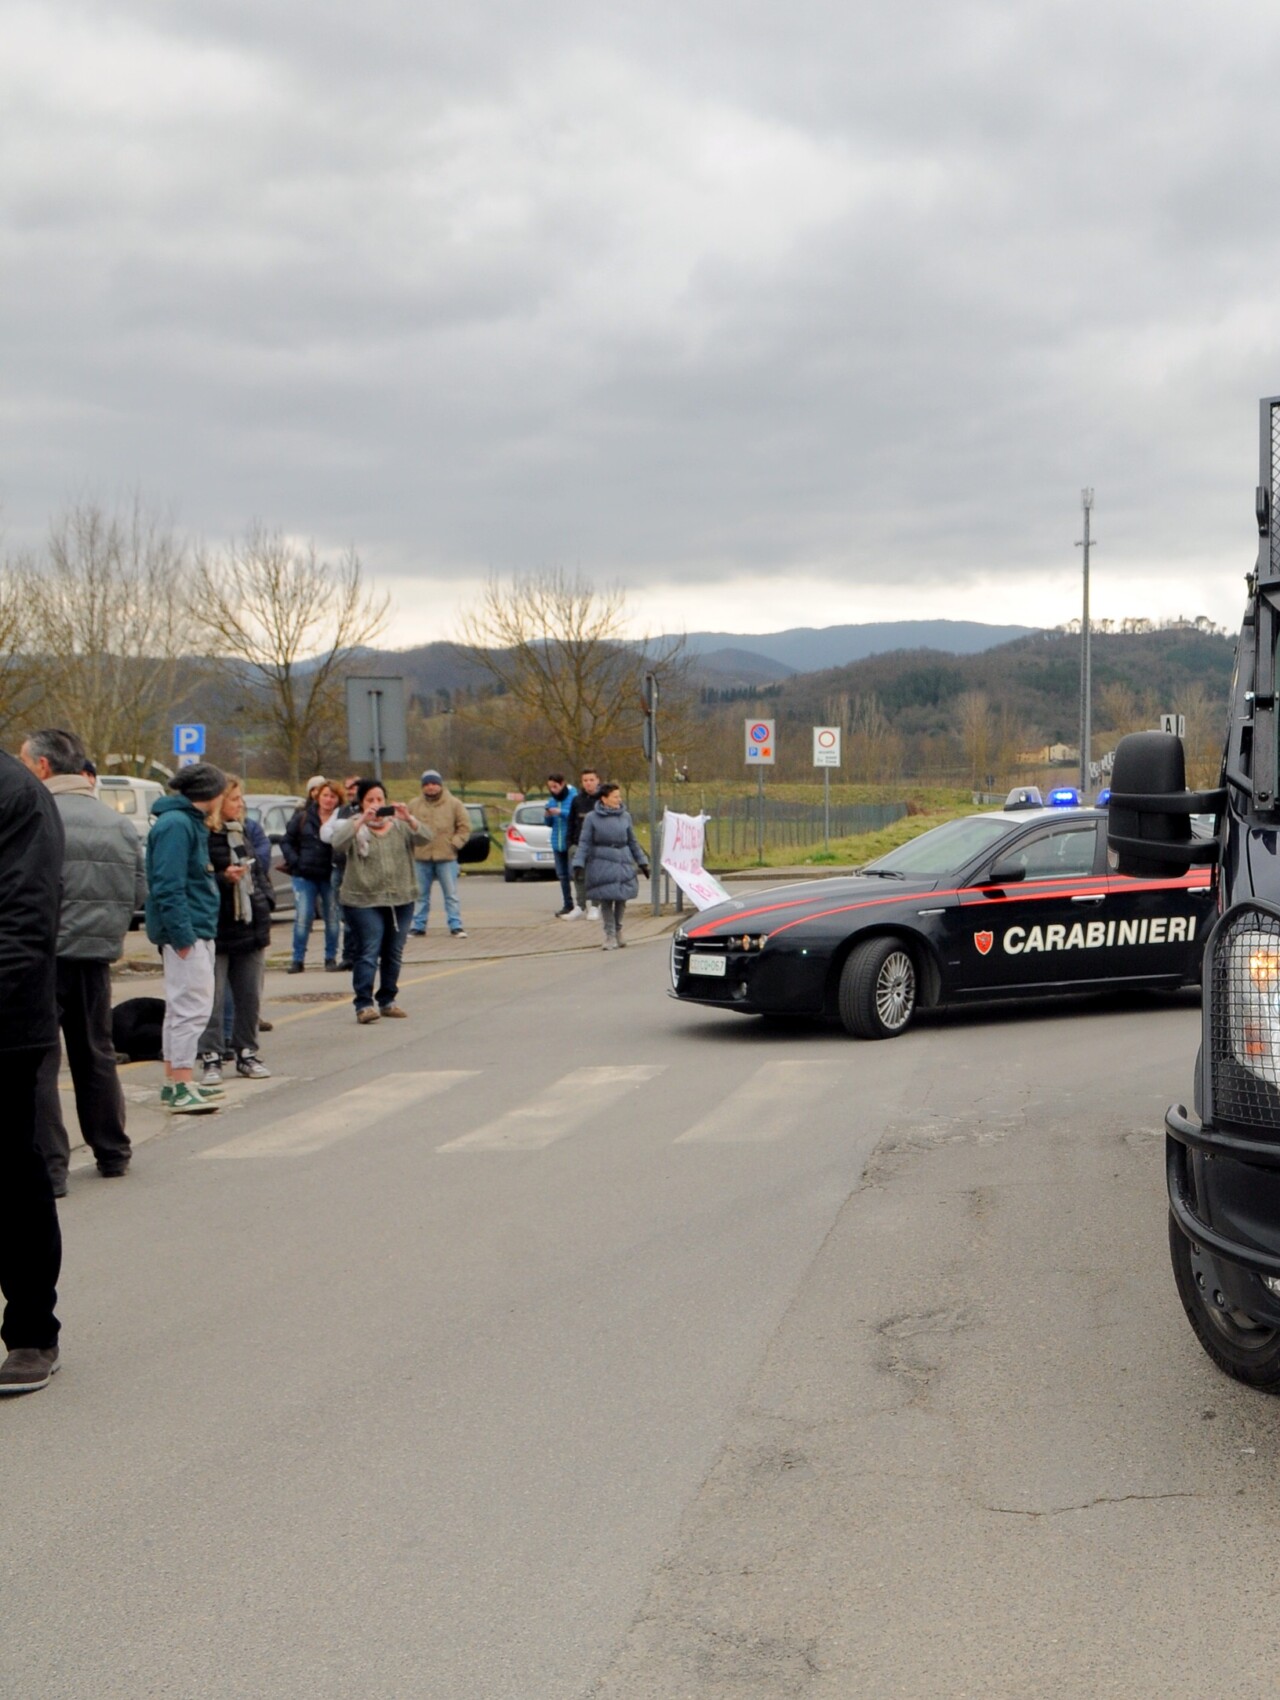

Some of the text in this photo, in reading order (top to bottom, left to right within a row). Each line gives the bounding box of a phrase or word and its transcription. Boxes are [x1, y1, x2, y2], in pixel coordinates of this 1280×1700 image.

[1165, 717, 1172, 733] A
[180, 728, 199, 752] P
[1003, 916, 1197, 955] CARABINIERI
